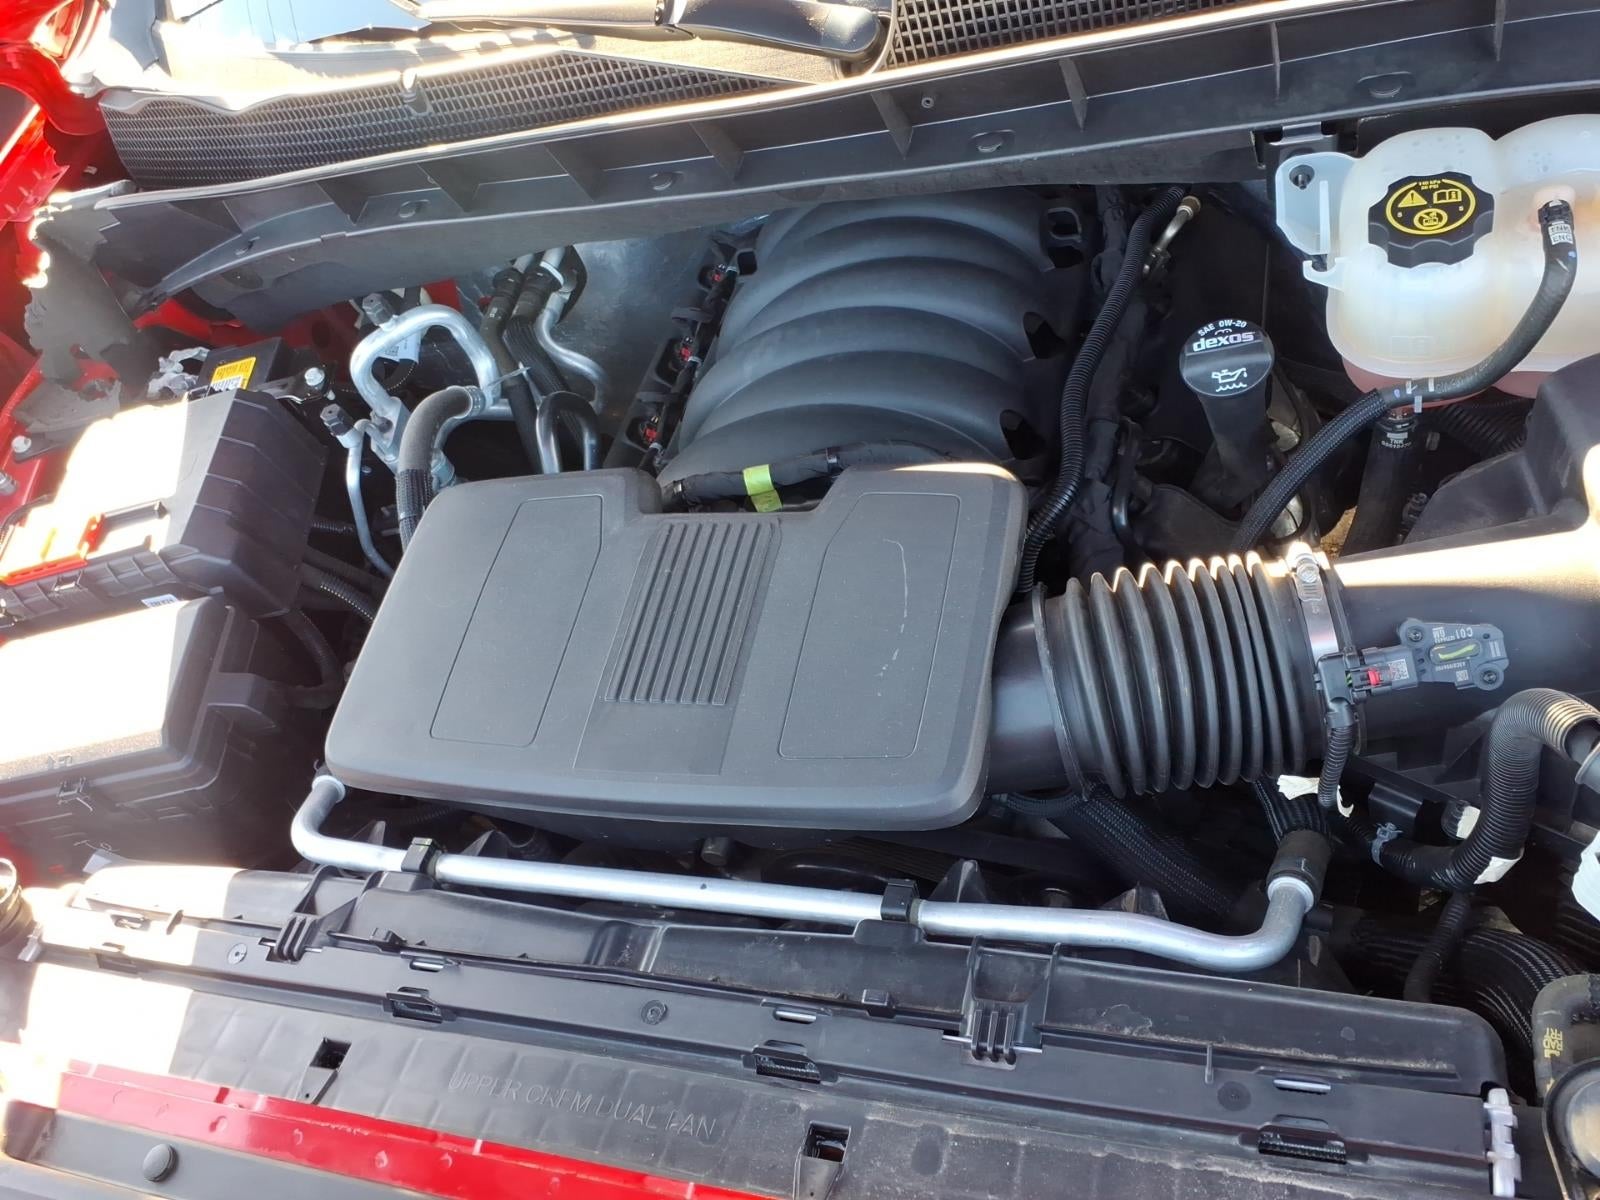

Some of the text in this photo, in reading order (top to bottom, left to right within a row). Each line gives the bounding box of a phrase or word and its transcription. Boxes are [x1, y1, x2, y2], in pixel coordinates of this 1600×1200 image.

[1198, 319, 1247, 336] SAE 0W-20
[1192, 331, 1256, 352] dexos
[1543, 1039, 1563, 1051] RAD
[448, 1070, 522, 1101] UPPER
[595, 1096, 657, 1129] DUAL
[664, 1109, 717, 1138] FAN
